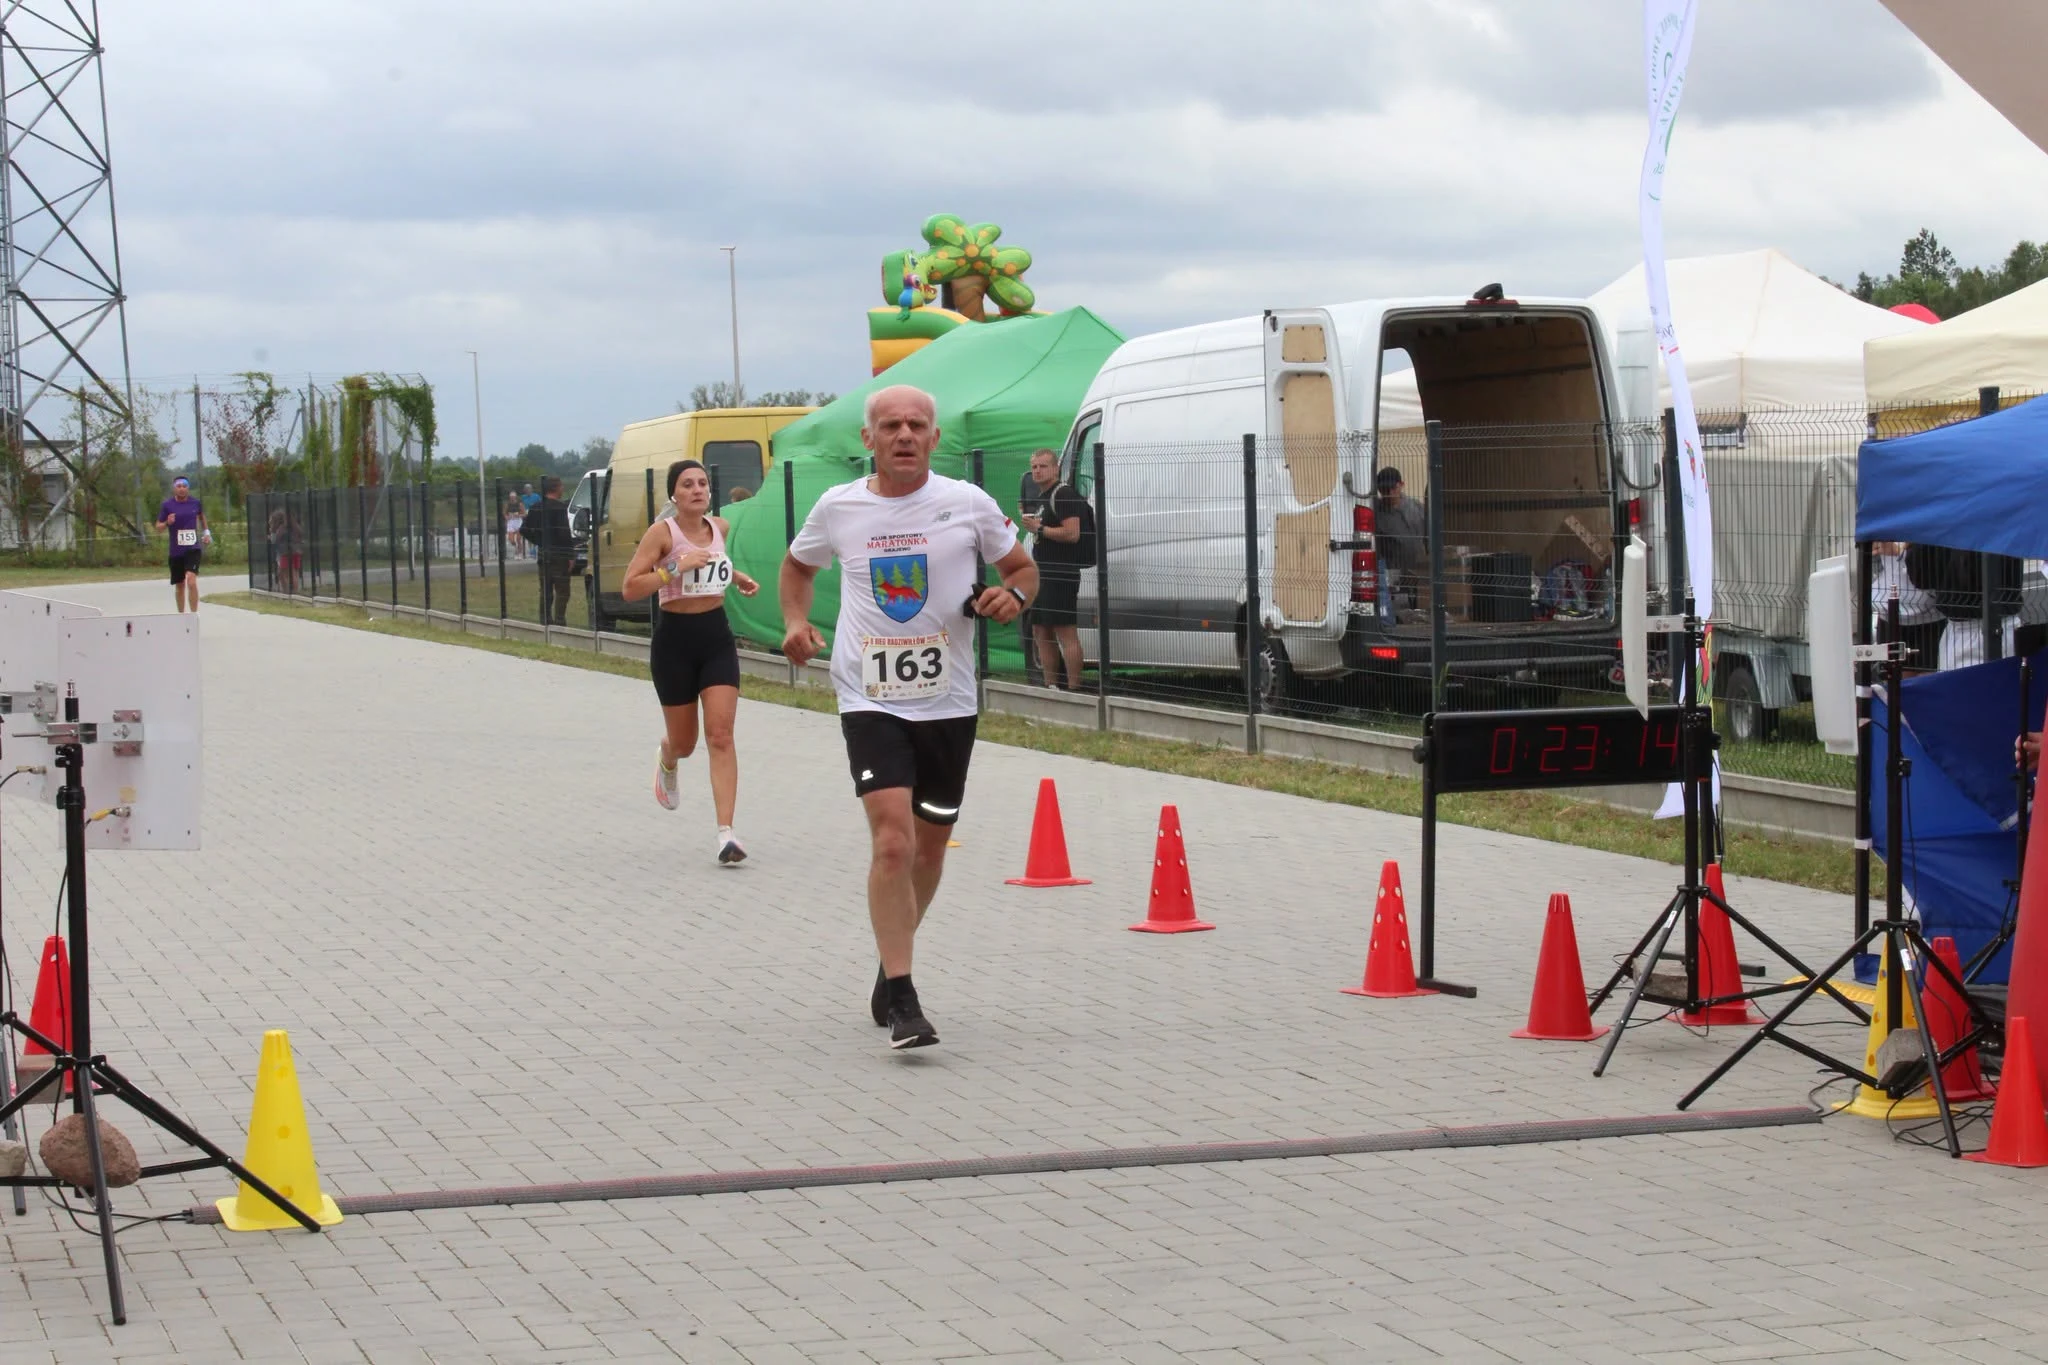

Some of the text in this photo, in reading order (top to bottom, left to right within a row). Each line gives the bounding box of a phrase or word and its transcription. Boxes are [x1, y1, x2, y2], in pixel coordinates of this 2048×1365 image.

[179, 533, 195, 541] 153
[866, 538, 928, 549] MARATONKA
[872, 647, 943, 683] 163
